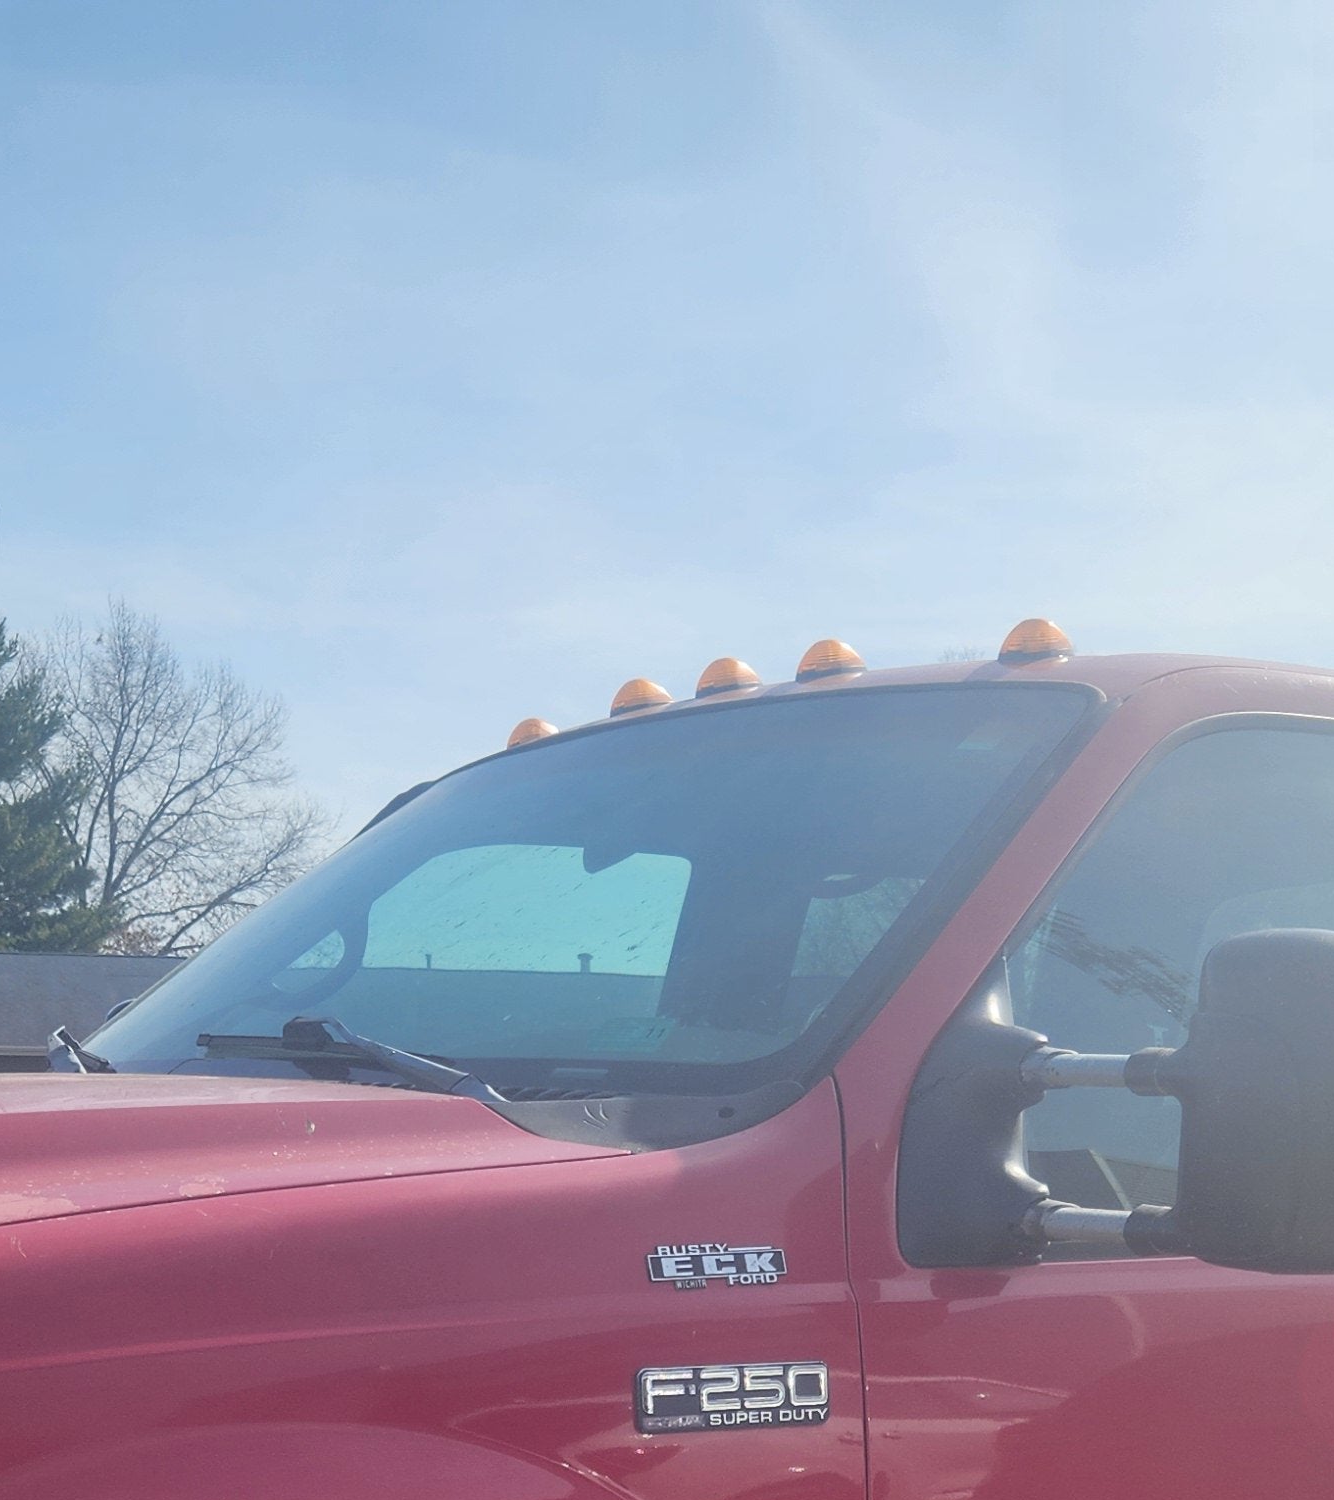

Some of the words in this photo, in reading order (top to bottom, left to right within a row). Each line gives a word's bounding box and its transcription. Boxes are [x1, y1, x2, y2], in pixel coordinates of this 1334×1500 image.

[657, 1243, 727, 1256] RUSTY
[660, 1252, 777, 1277] ECK
[675, 1279, 707, 1289] WICHITA
[728, 1273, 778, 1285] FORD
[641, 1364, 828, 1415] F-250
[709, 1411, 773, 1426] SUPER
[779, 1408, 829, 1422] DUTY
